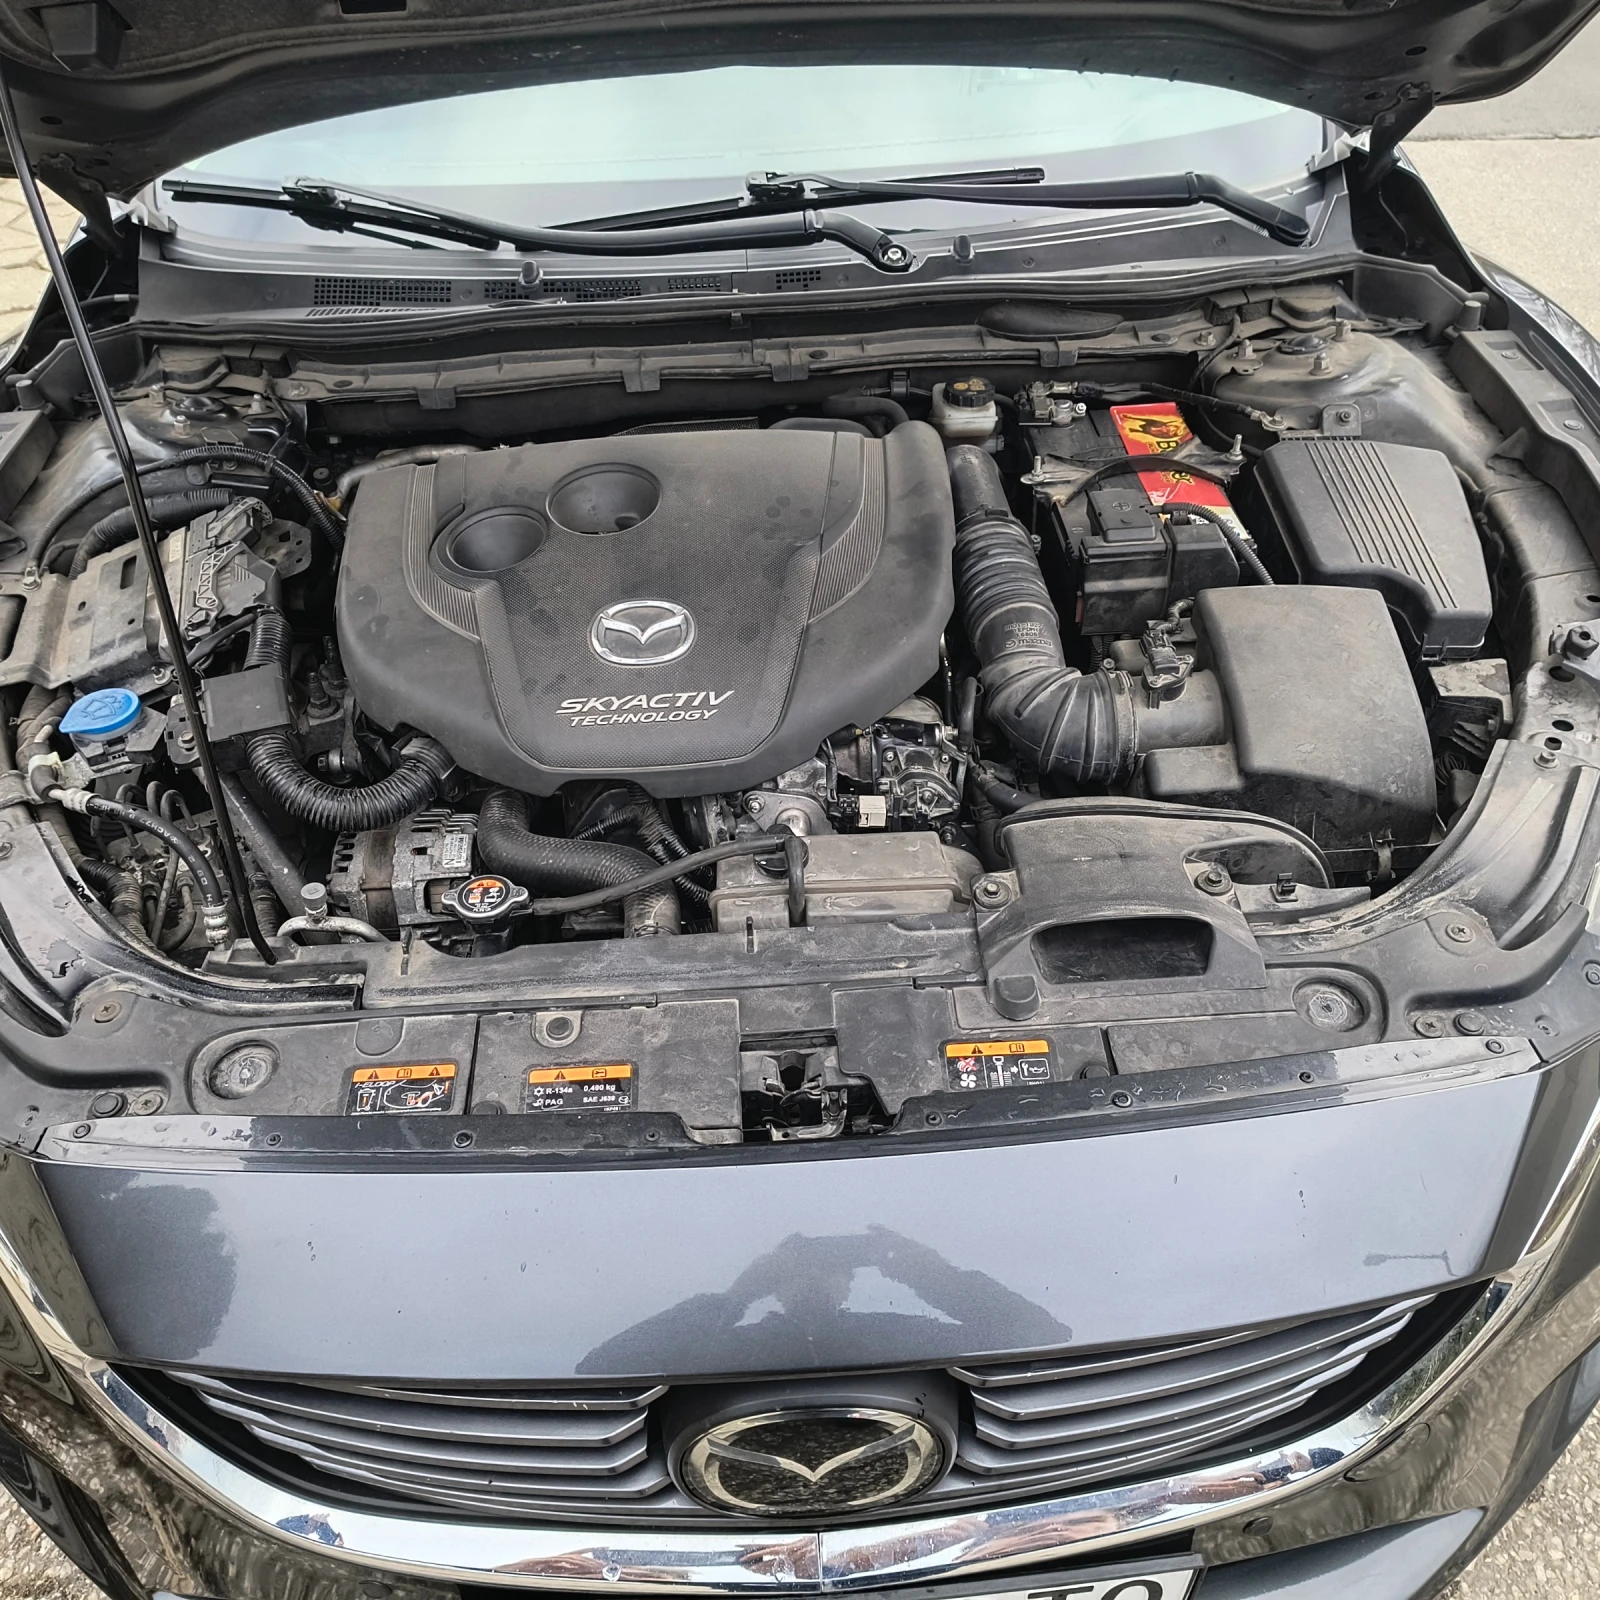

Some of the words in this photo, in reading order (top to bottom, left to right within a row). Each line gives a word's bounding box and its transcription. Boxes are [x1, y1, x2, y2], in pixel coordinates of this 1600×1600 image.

[555, 690, 735, 714] SKYACTIV
[570, 709, 719, 727] TECHNOLOGY
[545, 1086, 573, 1095] R-134a
[605, 1083, 616, 1092] kg
[544, 1098, 564, 1106] PAG
